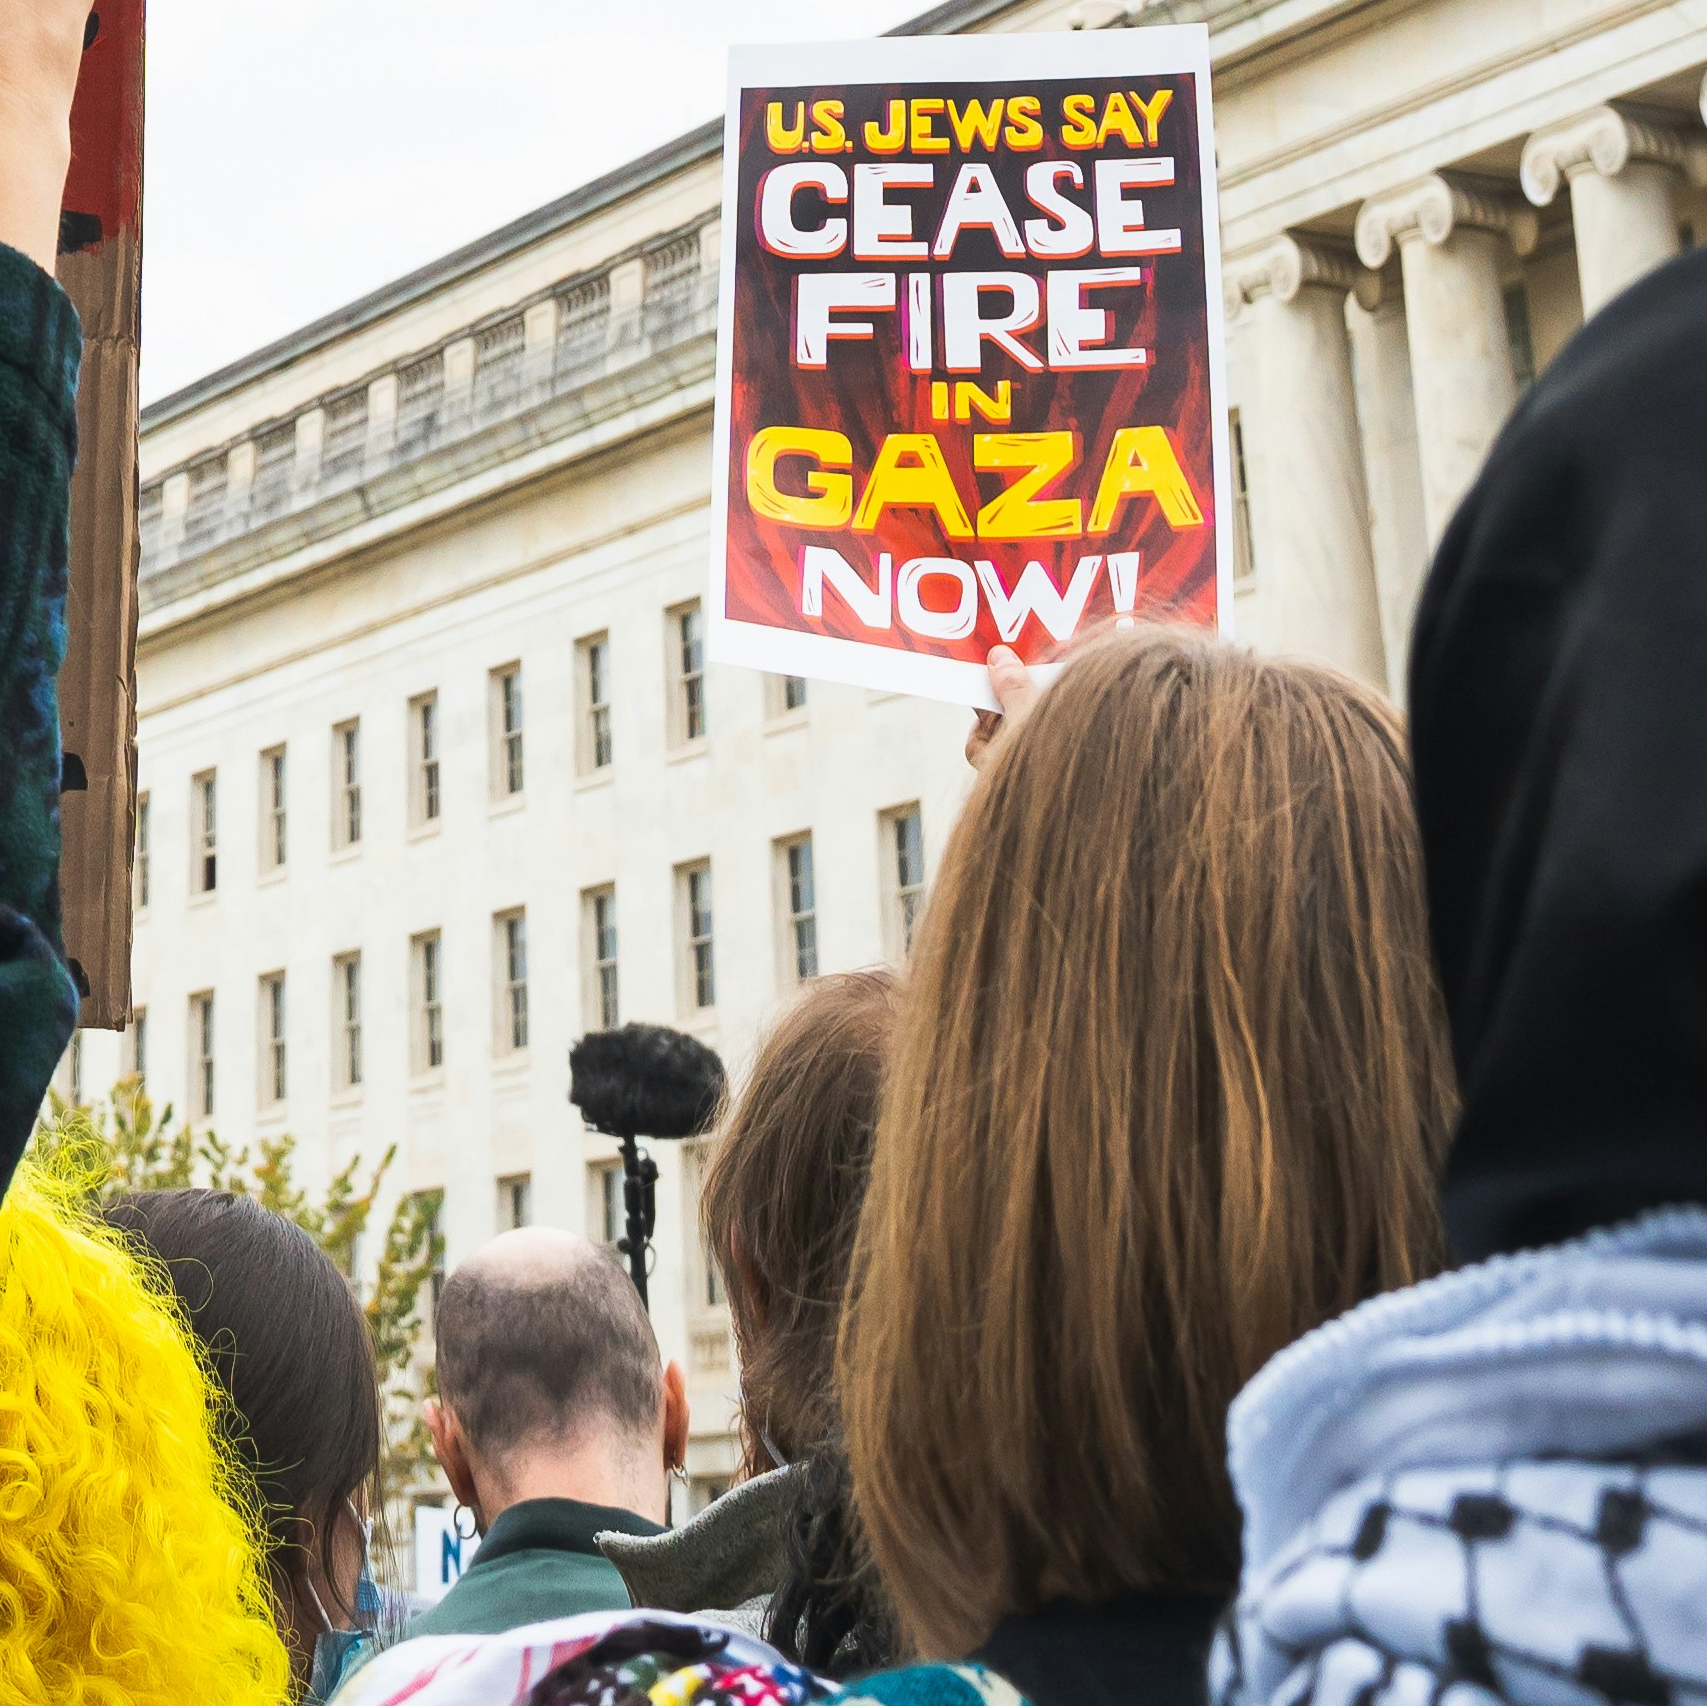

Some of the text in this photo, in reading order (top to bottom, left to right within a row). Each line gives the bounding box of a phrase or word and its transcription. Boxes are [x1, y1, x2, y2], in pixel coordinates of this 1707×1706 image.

[765, 90, 1174, 154] U.S. JEWS SAY
[757, 156, 1182, 260] CEASE
[792, 267, 1153, 374] FIRE
[931, 380, 1014, 424] IN
[743, 425, 1208, 542] GAZA
[799, 545, 1141, 643] NOW!
